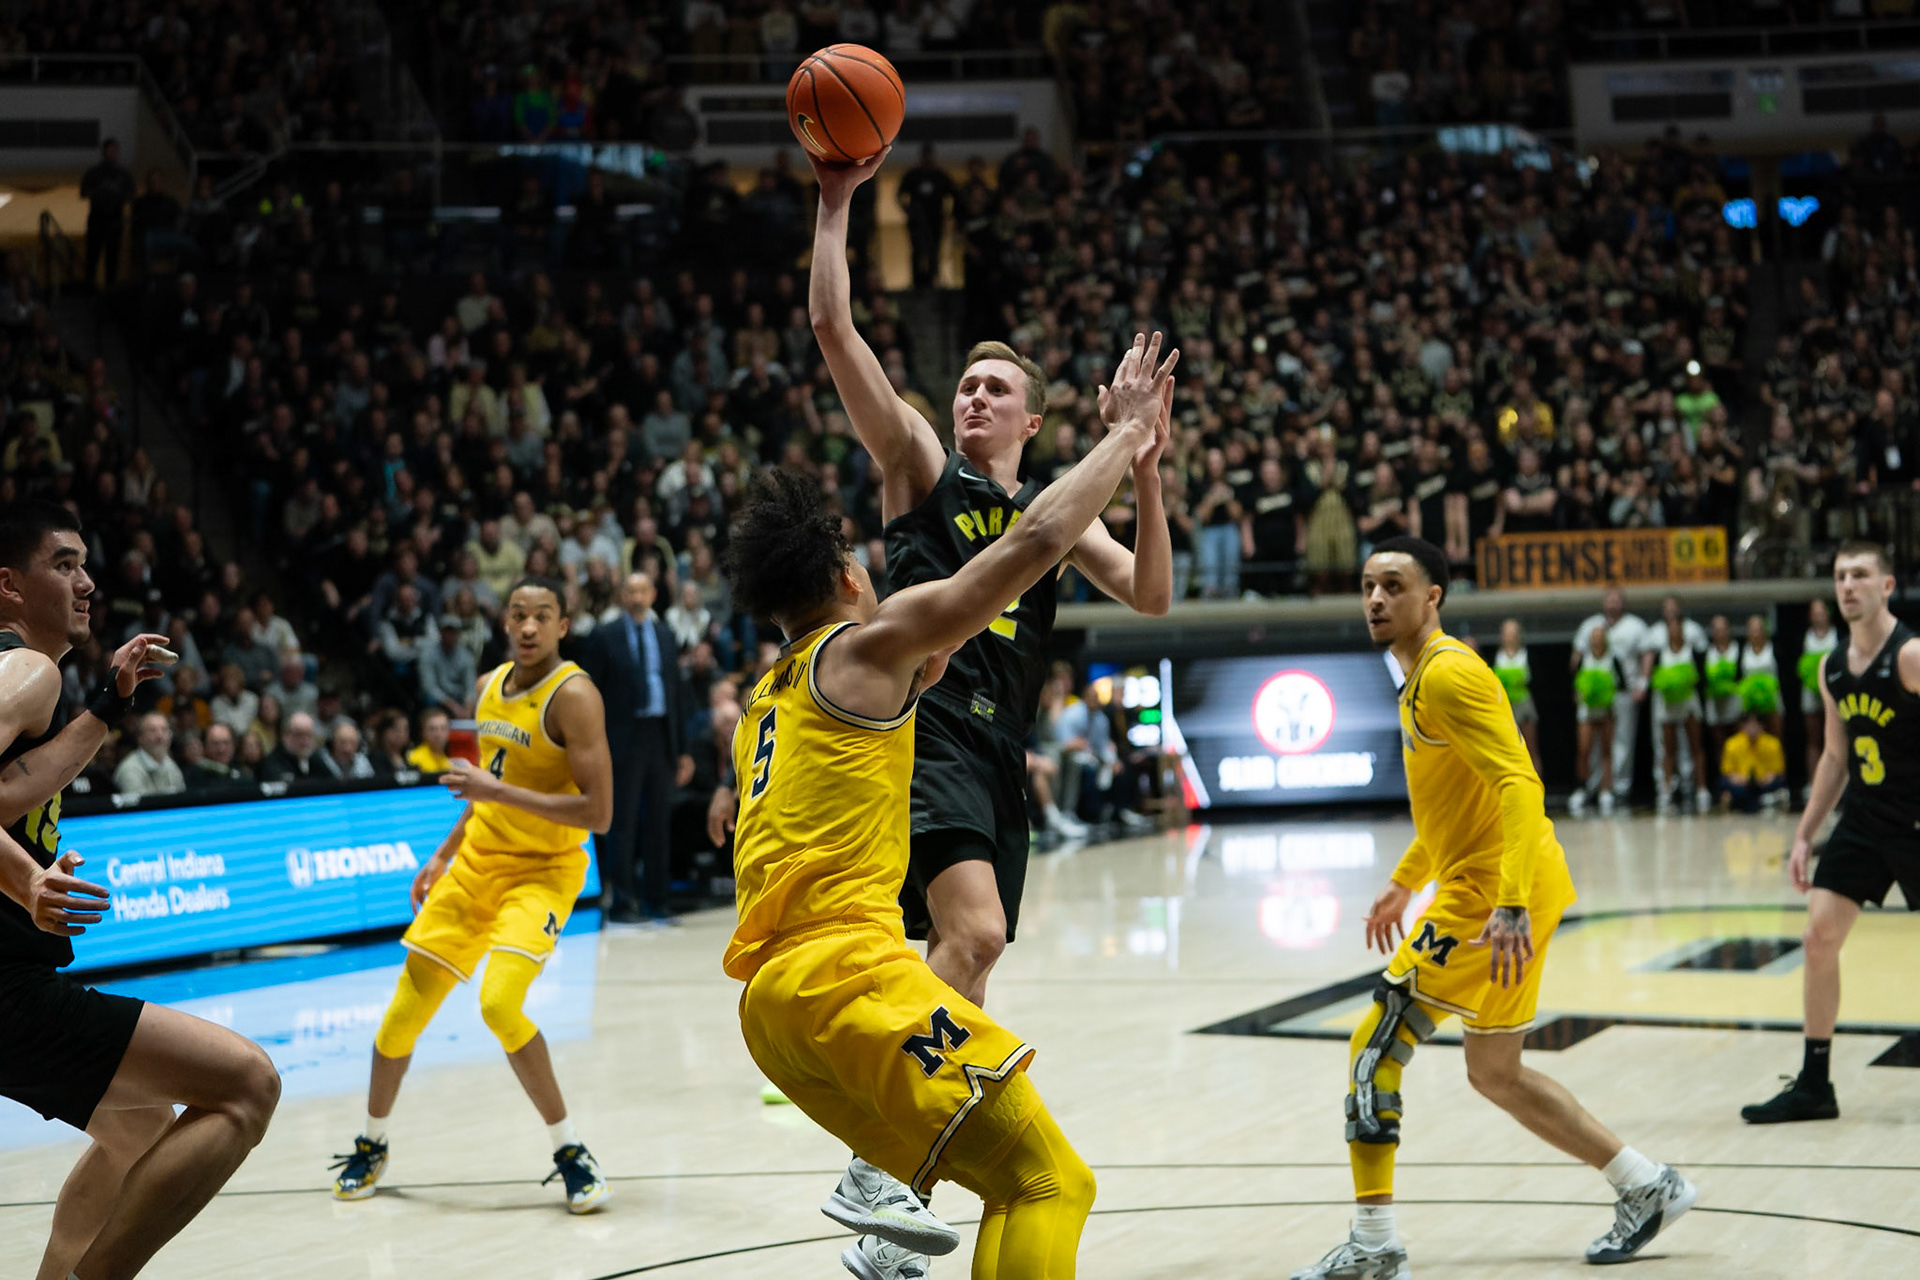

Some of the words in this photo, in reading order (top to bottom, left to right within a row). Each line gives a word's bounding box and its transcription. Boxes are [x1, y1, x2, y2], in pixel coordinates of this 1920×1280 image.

[1484, 537, 1619, 589] DEFENSE
[489, 747, 507, 780] 4
[751, 704, 777, 799] 5
[1853, 735, 1886, 786] 3
[106, 852, 167, 888] Central
[167, 848, 227, 880] Indiana
[312, 841, 419, 882] HONDA
[111, 889, 170, 922] Honda
[167, 882, 232, 916] Dealers
[1410, 919, 1460, 968] M
[900, 1004, 973, 1079] M
